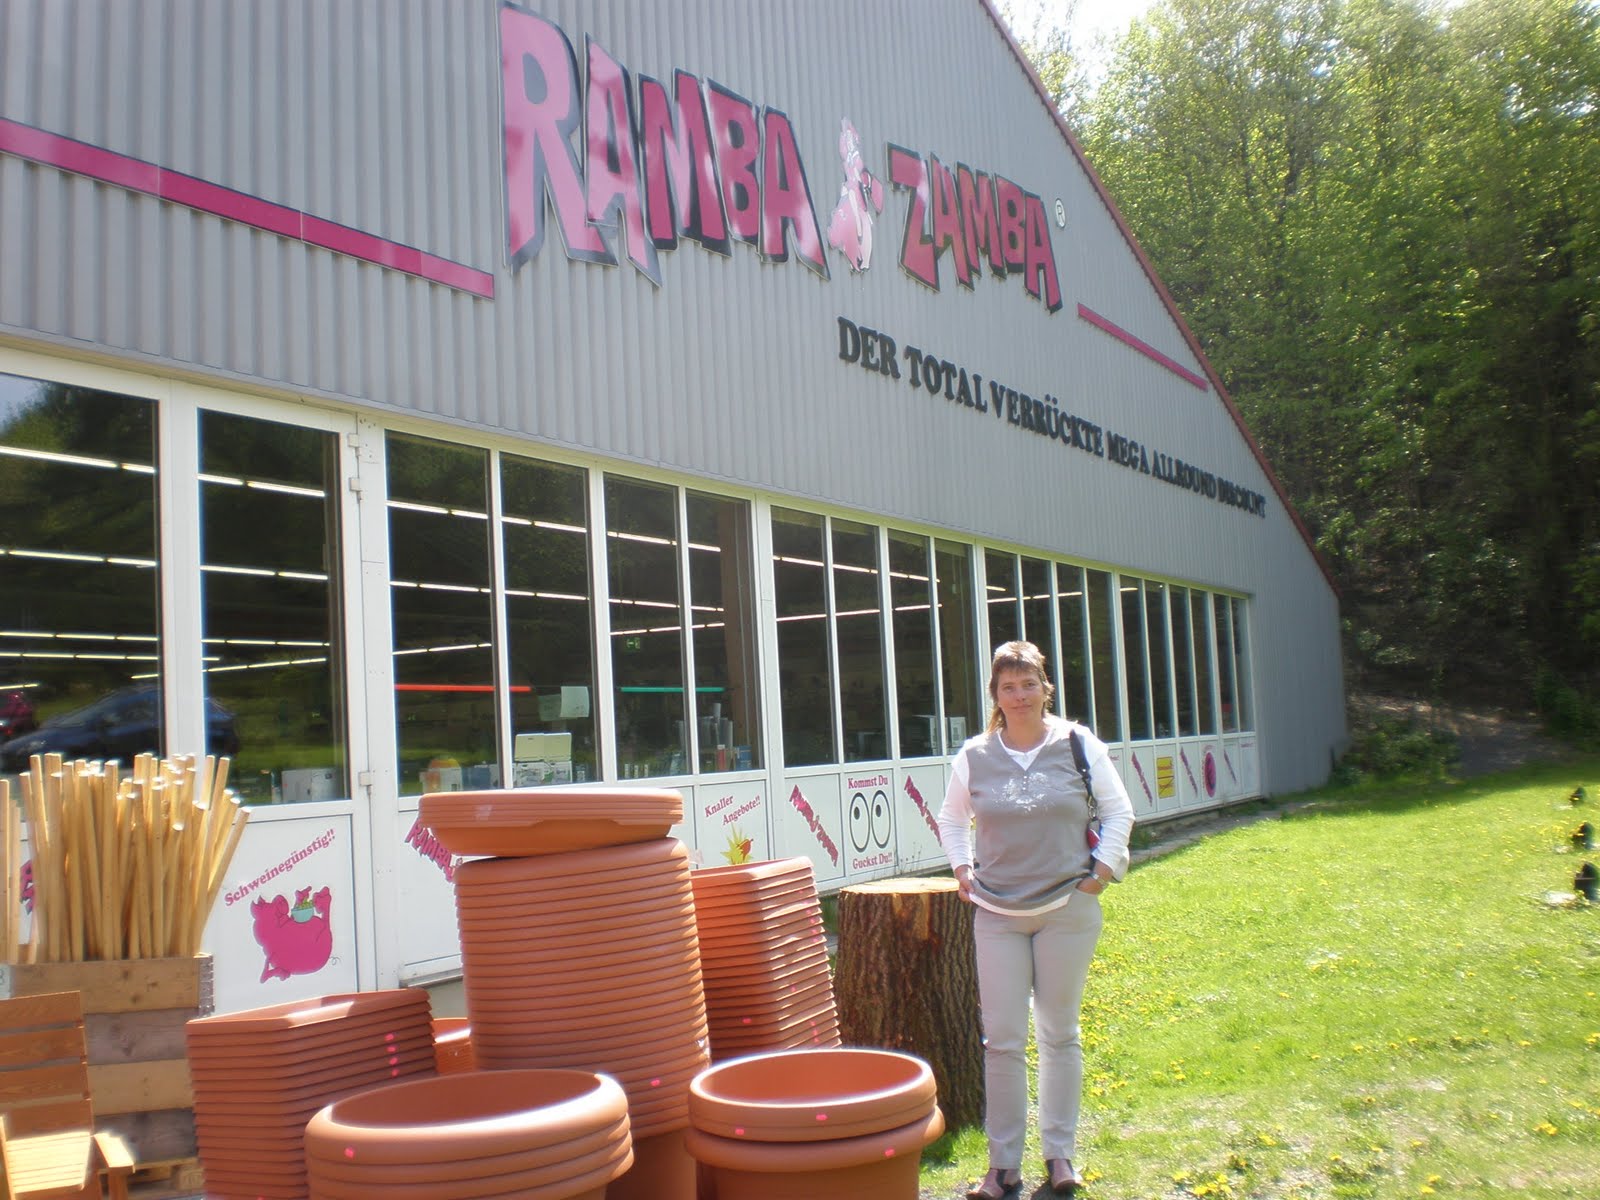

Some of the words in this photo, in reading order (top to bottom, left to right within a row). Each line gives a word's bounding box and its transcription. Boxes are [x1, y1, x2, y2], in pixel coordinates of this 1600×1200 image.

[499, 3, 830, 287] RAMBA
[886, 142, 1063, 314] ZAMBA
[838, 316, 900, 378] DER
[905, 345, 988, 412] TOTAL
[989, 380, 1104, 457] VERRÜCKTE
[1107, 430, 1150, 475] MEGA
[1152, 450, 1217, 499] ALLROUND
[847, 777, 877, 790] Kommst
[878, 775, 888, 786] Du
[704, 795, 734, 818] Knaller
[721, 796, 761, 826] Angebote!!
[224, 828, 336, 906] Schweinegünstig!!
[852, 856, 877, 870] Guckst
